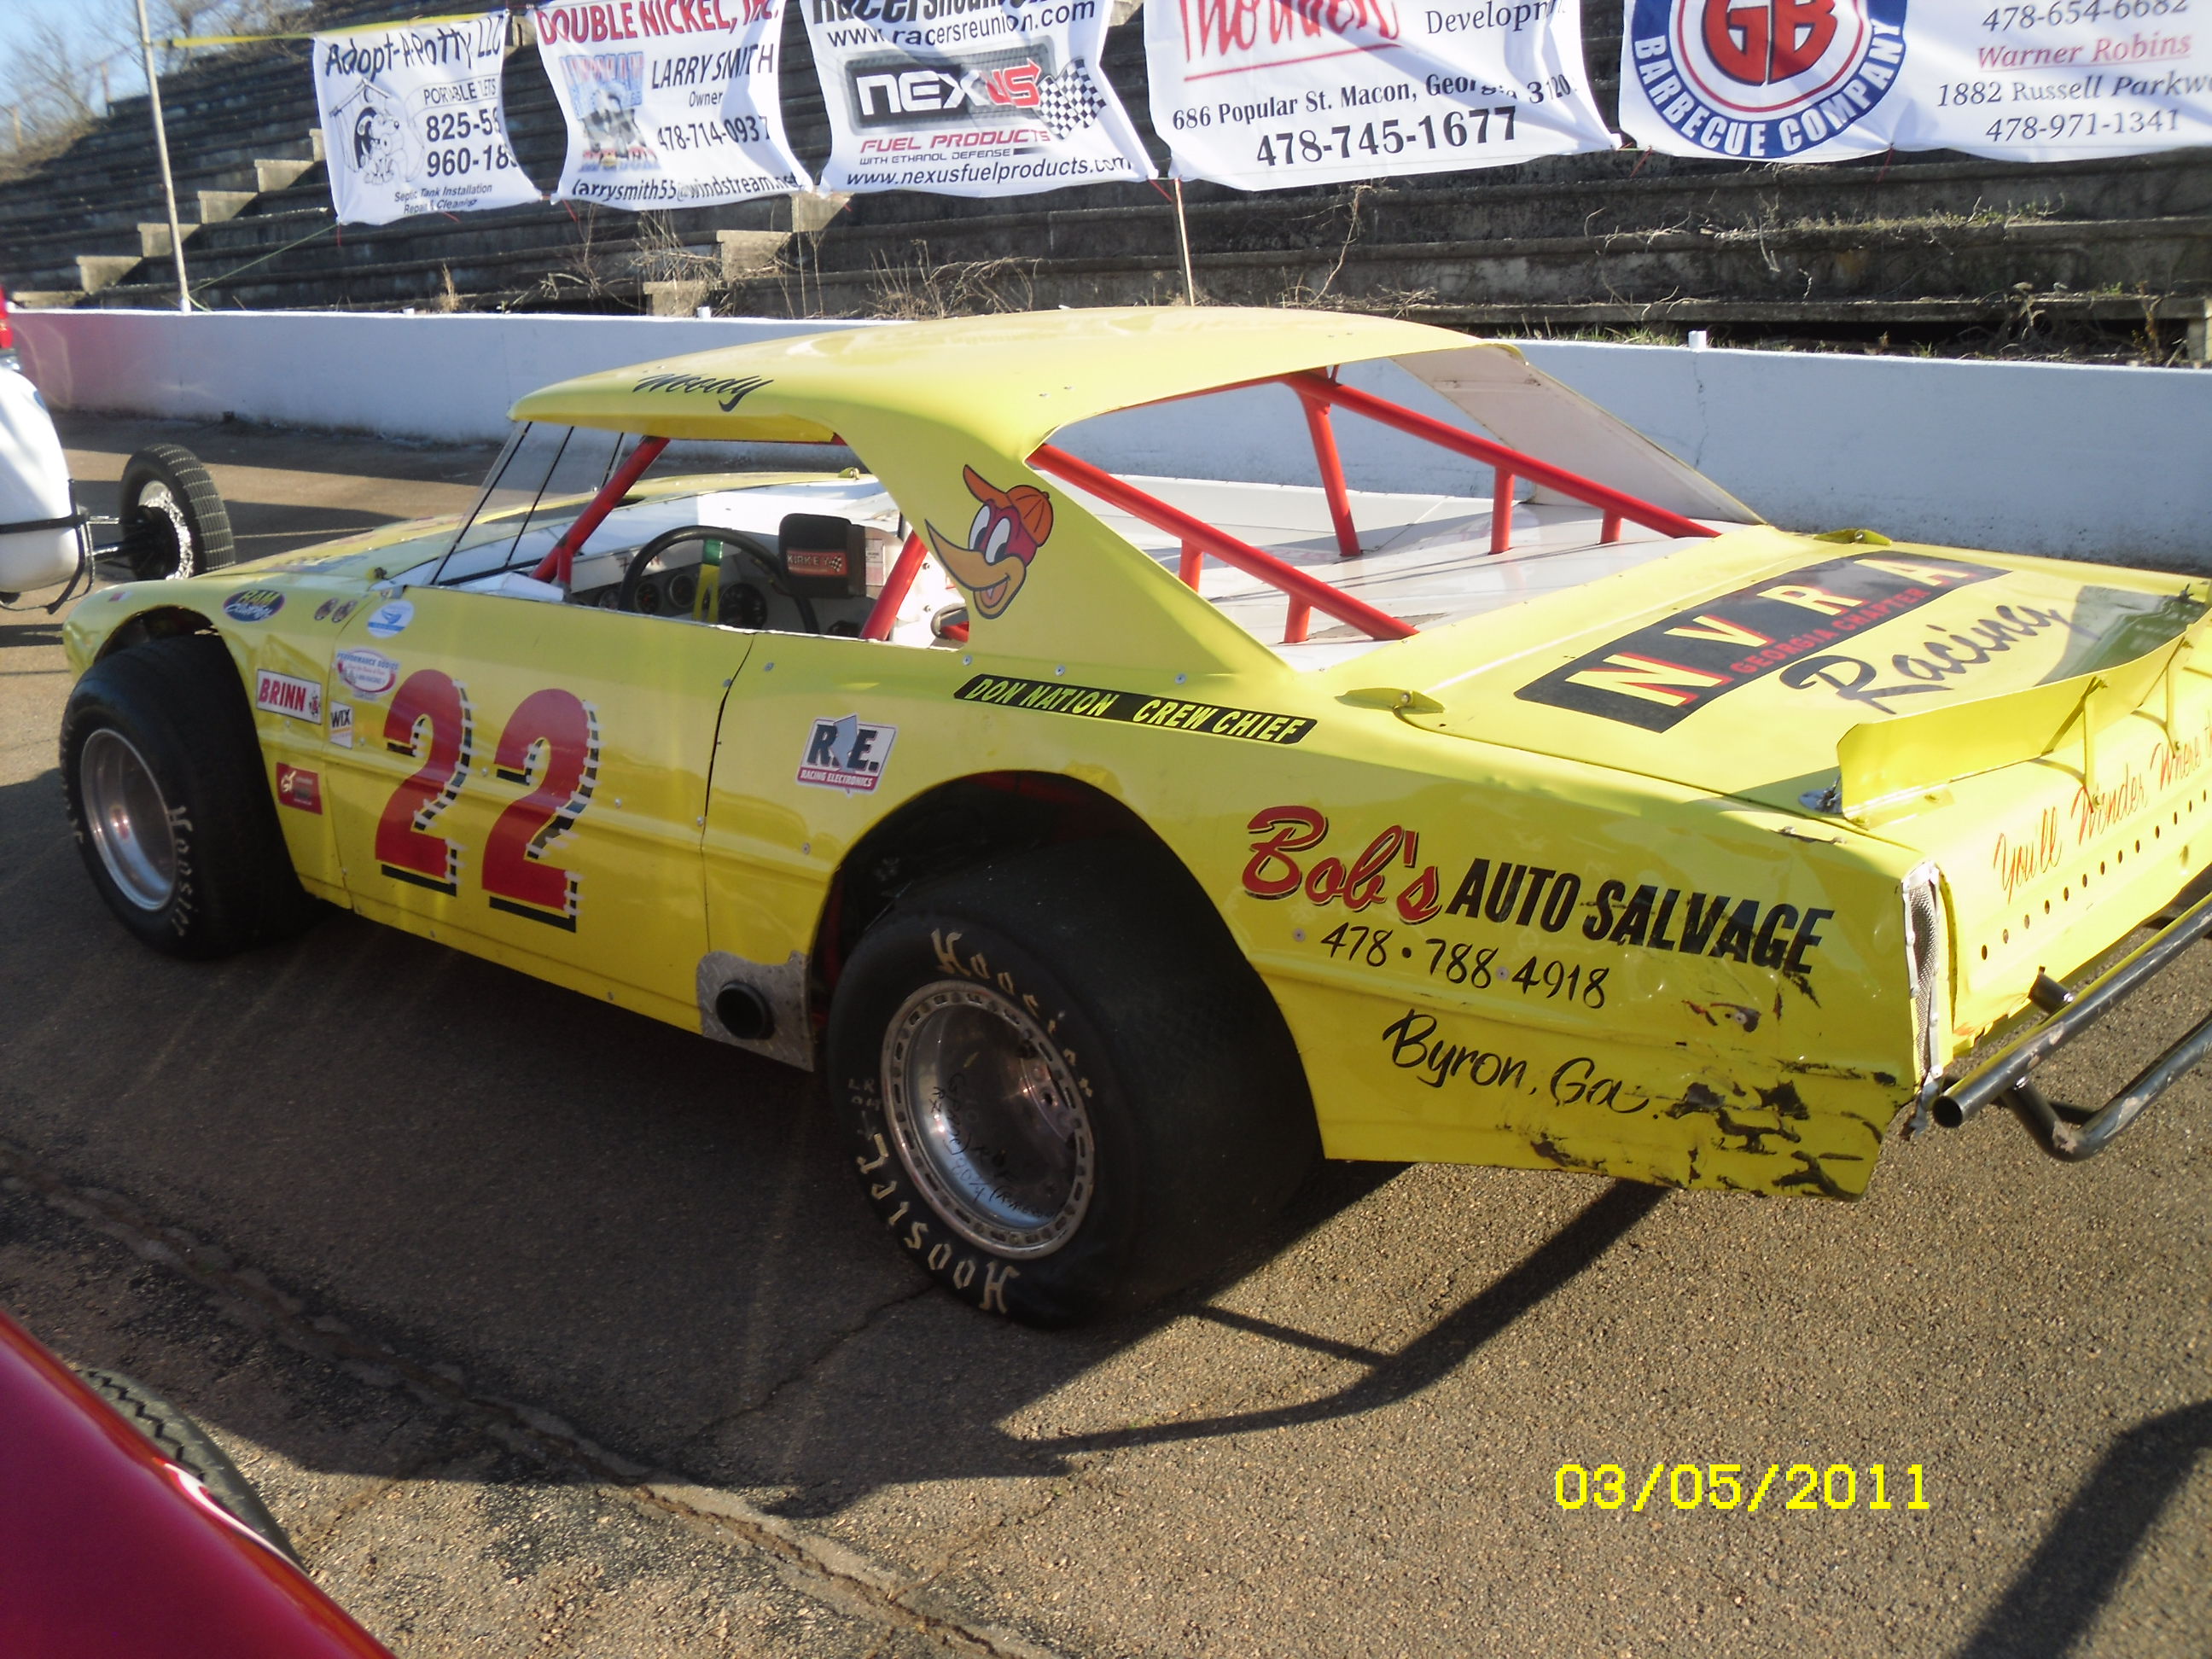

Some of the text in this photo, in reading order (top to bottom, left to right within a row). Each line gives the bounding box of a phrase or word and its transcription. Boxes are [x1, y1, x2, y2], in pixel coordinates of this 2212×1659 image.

[535, 2, 638, 45] DOUBLE
[639, 0, 738, 37] NICKEL,
[826, 1, 1095, 48] www.racersreunion.com
[651, 54, 713, 90] LARRY
[712, 44, 774, 81] SMITH
[1977, 31, 2193, 69] Warner Robins
[689, 90, 724, 108] Owner
[1172, 108, 1212, 131] 686
[1219, 96, 1299, 125] Popular
[1306, 90, 1332, 113] St.
[1341, 83, 1417, 108] Macon,
[1527, 73, 1577, 104] 3120
[1633, 34, 1767, 158] BARBECUE
[1778, 18, 1904, 153] COMPANY
[1937, 81, 2002, 108] 1882
[2011, 74, 2103, 102] Russell
[657, 115, 771, 151] 478-714-0937
[860, 129, 1051, 154] FUEL PRODUCTS
[1256, 105, 1518, 167] 478-745-1677
[1985, 109, 2180, 143] 478-971-1341
[427, 144, 518, 178] 960-18
[846, 157, 1132, 186] www.nexusfuelproducts.com
[859, 148, 1011, 166] WITH ETHANOL DEFENSE
[420, 188, 440, 198] Tank
[442, 183, 492, 196] Installation
[632, 373, 775, 413] Woody
[1729, 586, 1932, 674] GEORGIA CHAPTER
[1778, 604, 2102, 715] Racing
[259, 678, 307, 713] BRINN
[330, 708, 352, 728] WIX
[964, 678, 1307, 742] DON NATION CREW CHIEF
[375, 668, 602, 932] 22
[2070, 762, 2148, 847] Wonder
[1240, 804, 1835, 975] Bob's AUTO SALVAGE
[1382, 1008, 1538, 1097] Byron,
